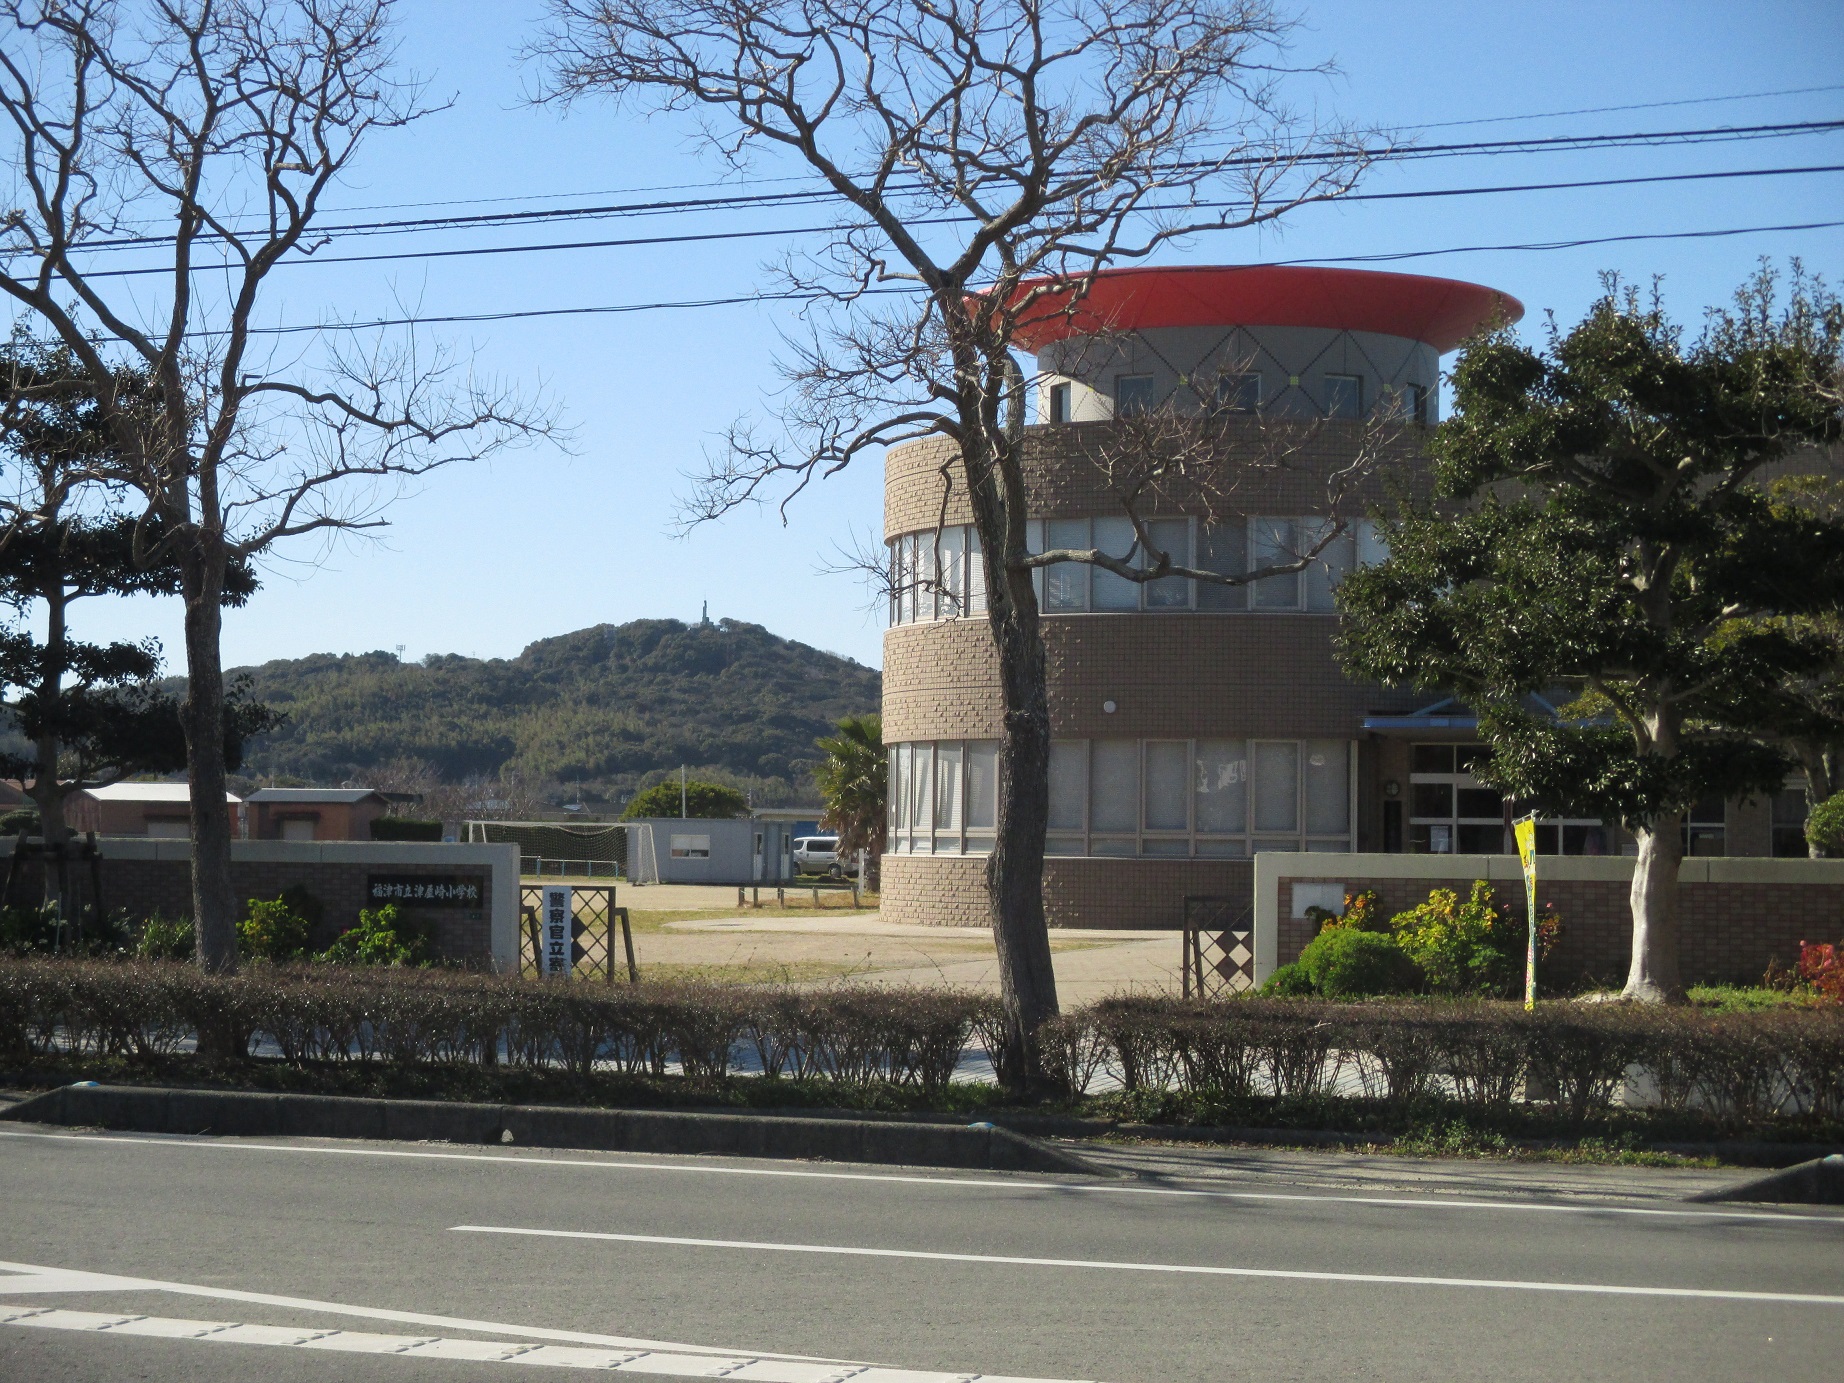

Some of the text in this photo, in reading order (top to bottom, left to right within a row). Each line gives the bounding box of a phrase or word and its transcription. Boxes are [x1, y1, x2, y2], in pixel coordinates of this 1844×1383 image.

[372, 883, 478, 899] 福津市立津屋崎小学校
